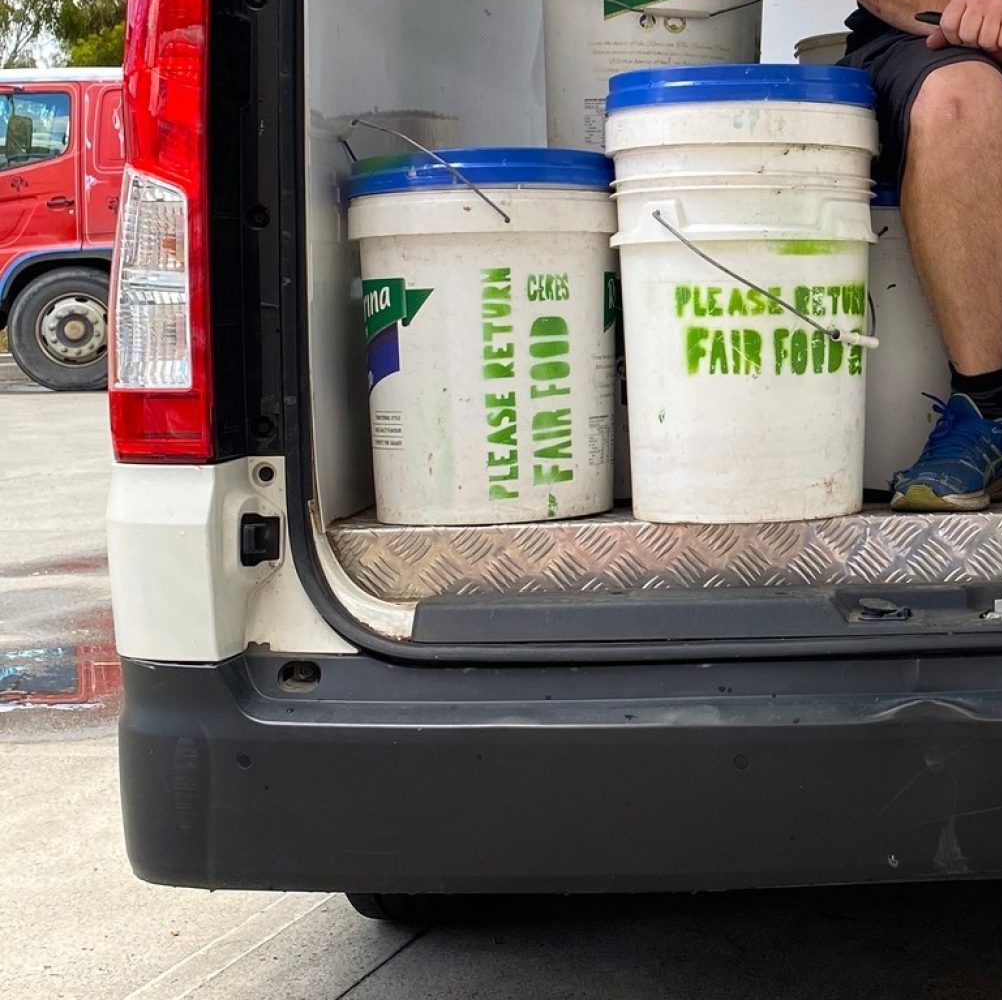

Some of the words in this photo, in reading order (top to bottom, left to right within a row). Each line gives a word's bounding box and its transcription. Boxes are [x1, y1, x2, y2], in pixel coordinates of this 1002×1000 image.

[481, 267, 515, 380] RETURN
[527, 273, 570, 302] CERES
[674, 284, 783, 318] PLEASE
[529, 316, 571, 399] FOOD
[685, 326, 763, 376] FAIR
[773, 327, 844, 376] FOOD
[485, 391, 519, 501] PLEASE
[532, 408, 574, 486] FAIR
